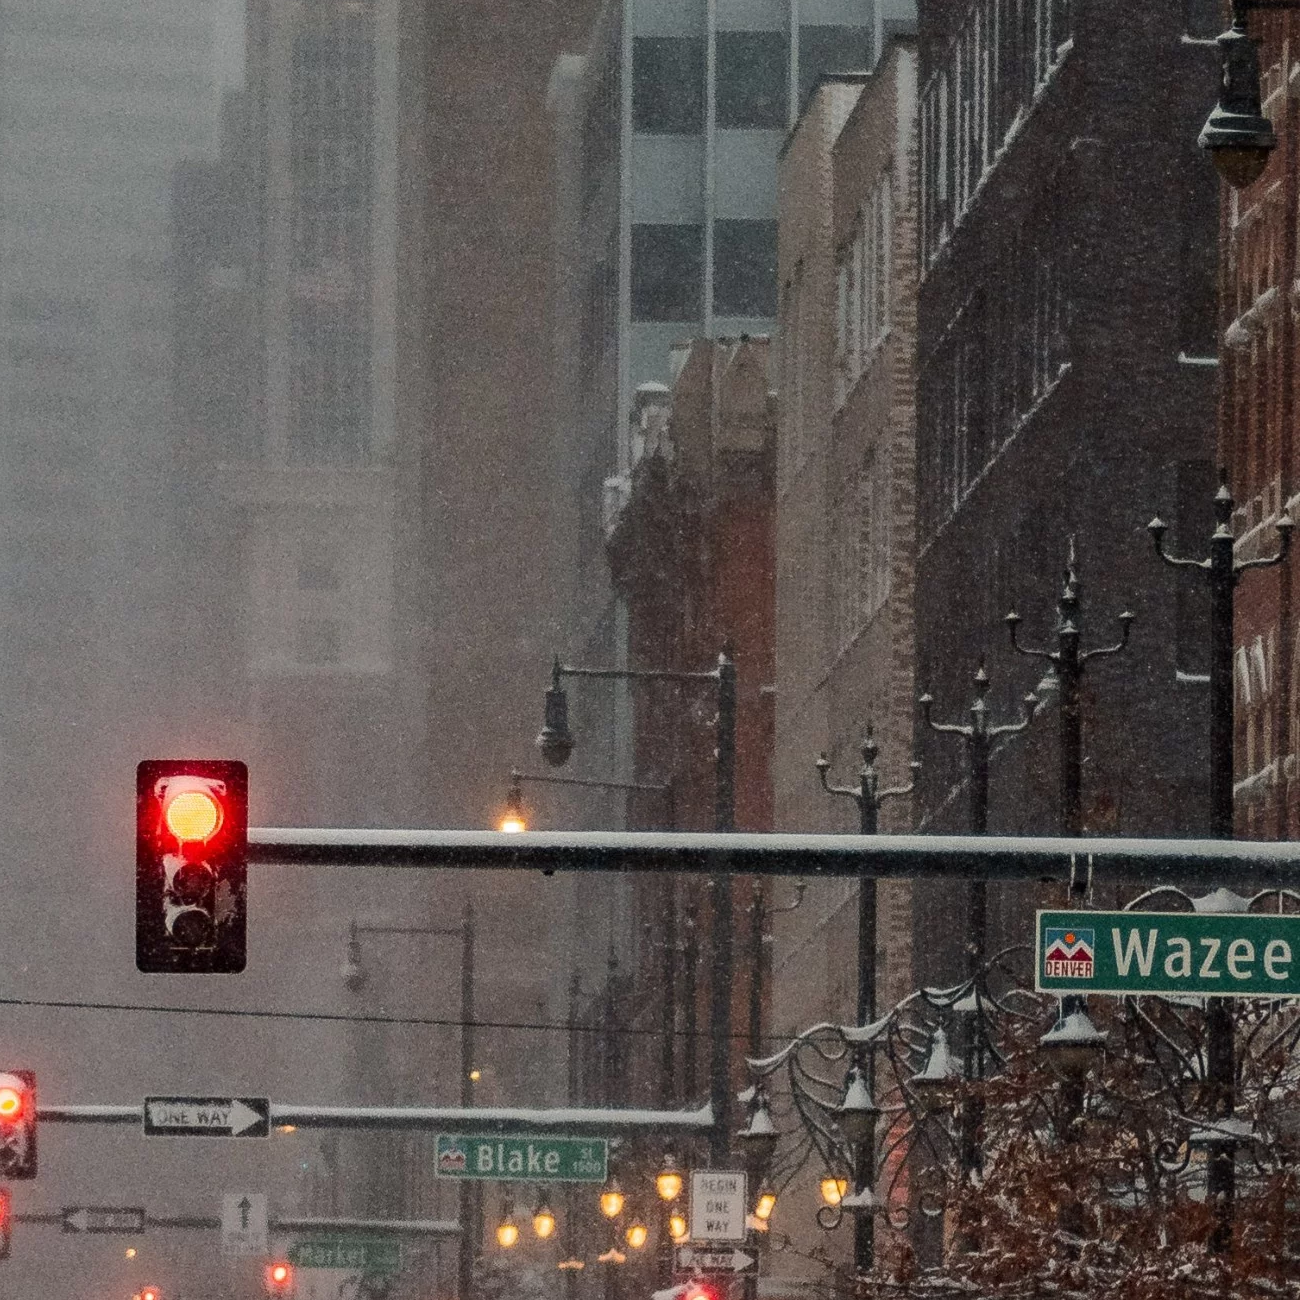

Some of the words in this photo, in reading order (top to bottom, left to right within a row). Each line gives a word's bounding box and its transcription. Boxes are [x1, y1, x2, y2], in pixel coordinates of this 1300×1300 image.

[1111, 927, 1292, 981] Wazee
[1045, 961, 1093, 977] DENVER
[156, 1107, 189, 1125] ONE
[197, 1108, 229, 1126] WAY
[477, 1143, 560, 1173] Blake
[701, 1179, 737, 1192] BEGIN
[706, 1199, 729, 1214] ONE
[706, 1219, 729, 1233] WAY
[298, 1244, 367, 1265] Market
